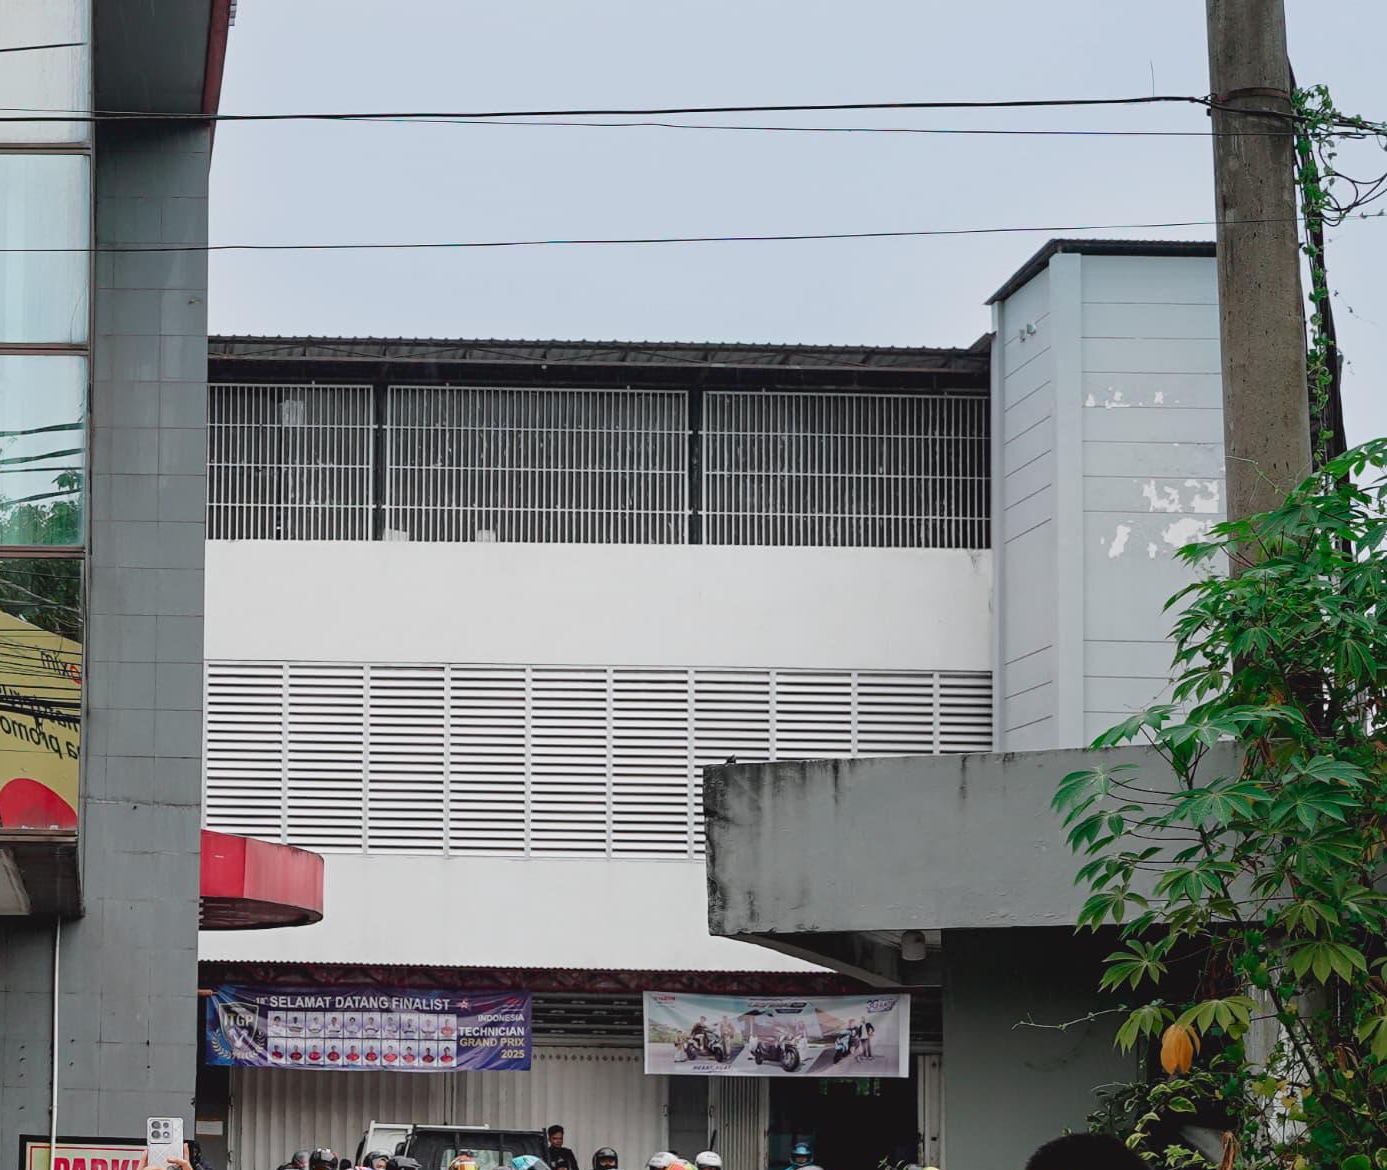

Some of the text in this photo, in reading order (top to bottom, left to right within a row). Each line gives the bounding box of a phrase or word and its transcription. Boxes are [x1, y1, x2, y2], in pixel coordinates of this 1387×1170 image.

[269, 996, 332, 1010] SELAMAT
[335, 996, 389, 1010] DATANG
[391, 997, 450, 1011] FINALIST
[478, 1013, 525, 1023] INDONESIA
[459, 1026, 525, 1036] TECHNICIAN
[459, 1037, 525, 1048] GRAND PRIX
[500, 1049, 525, 1059] 2025
